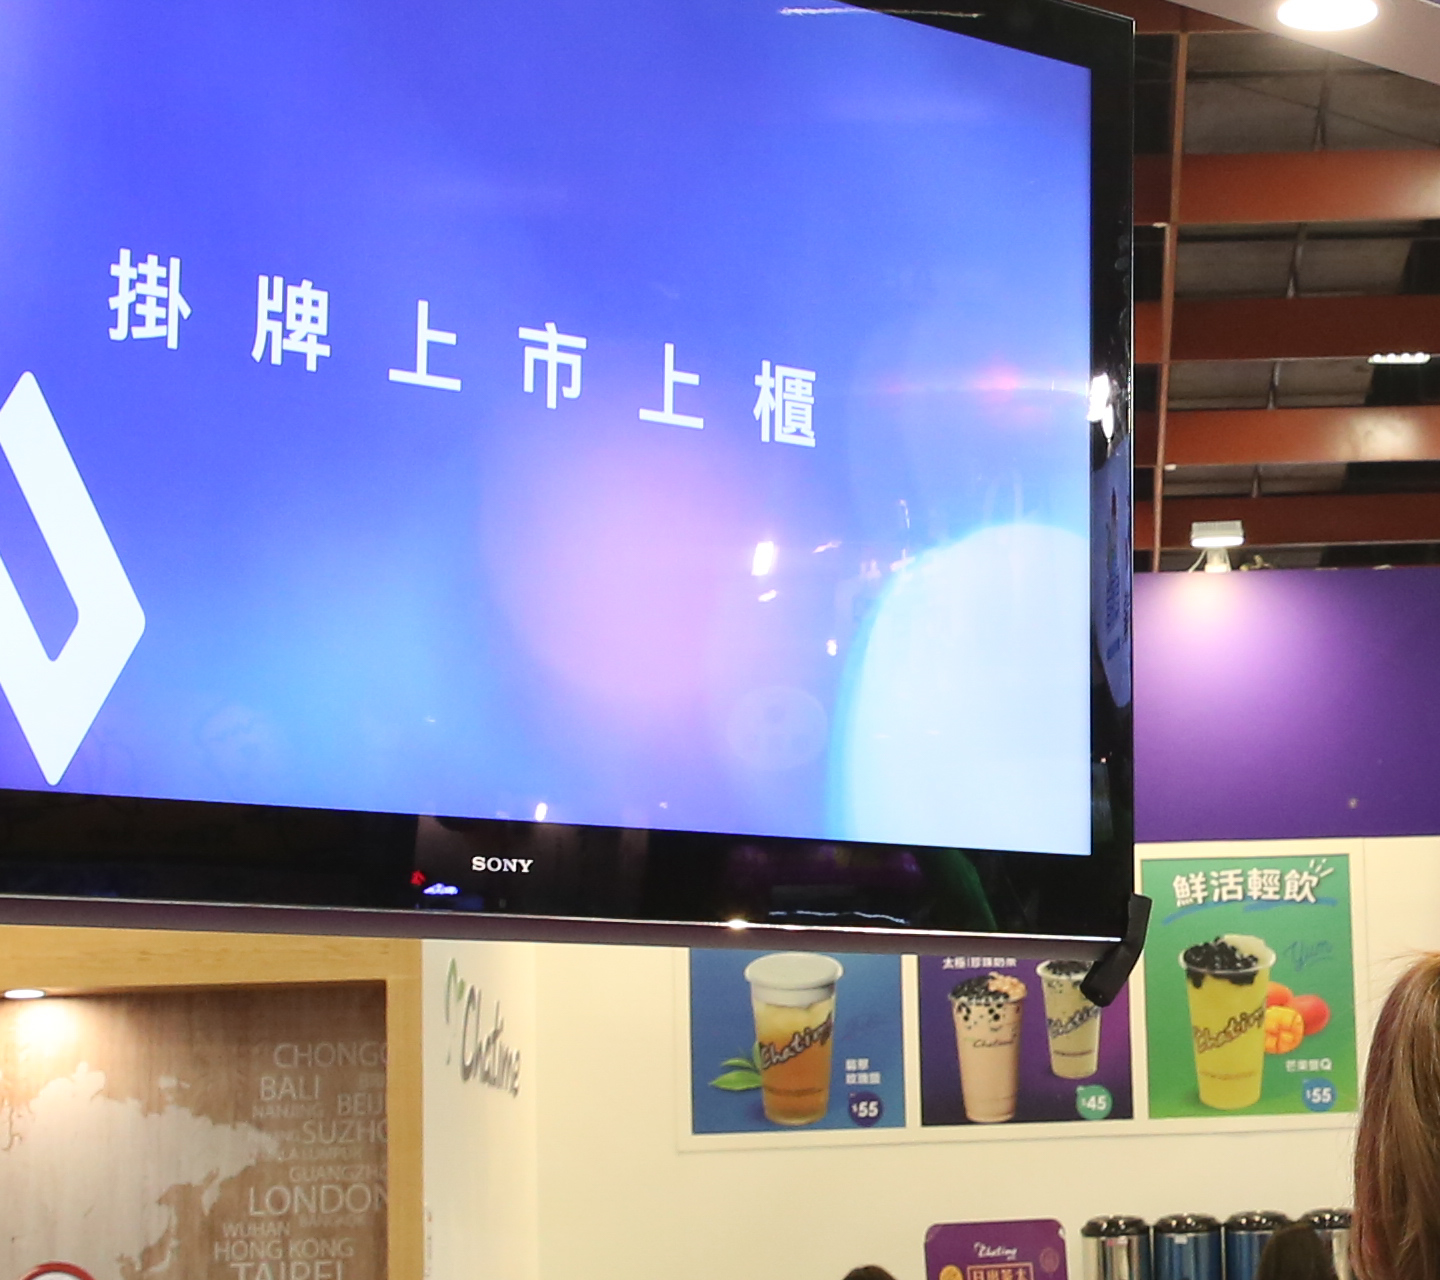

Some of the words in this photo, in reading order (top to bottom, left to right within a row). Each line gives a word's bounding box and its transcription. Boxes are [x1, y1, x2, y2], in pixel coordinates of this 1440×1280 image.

[108, 249, 817, 450] 掛牌上市上櫃
[471, 855, 534, 873] SONY
[1172, 867, 1320, 907] 鮮活輕飲
[260, 1074, 321, 1101] BALI
[1306, 1086, 1332, 1104] $55
[214, 1239, 283, 1261] HONG
[289, 1237, 354, 1259] KONG
